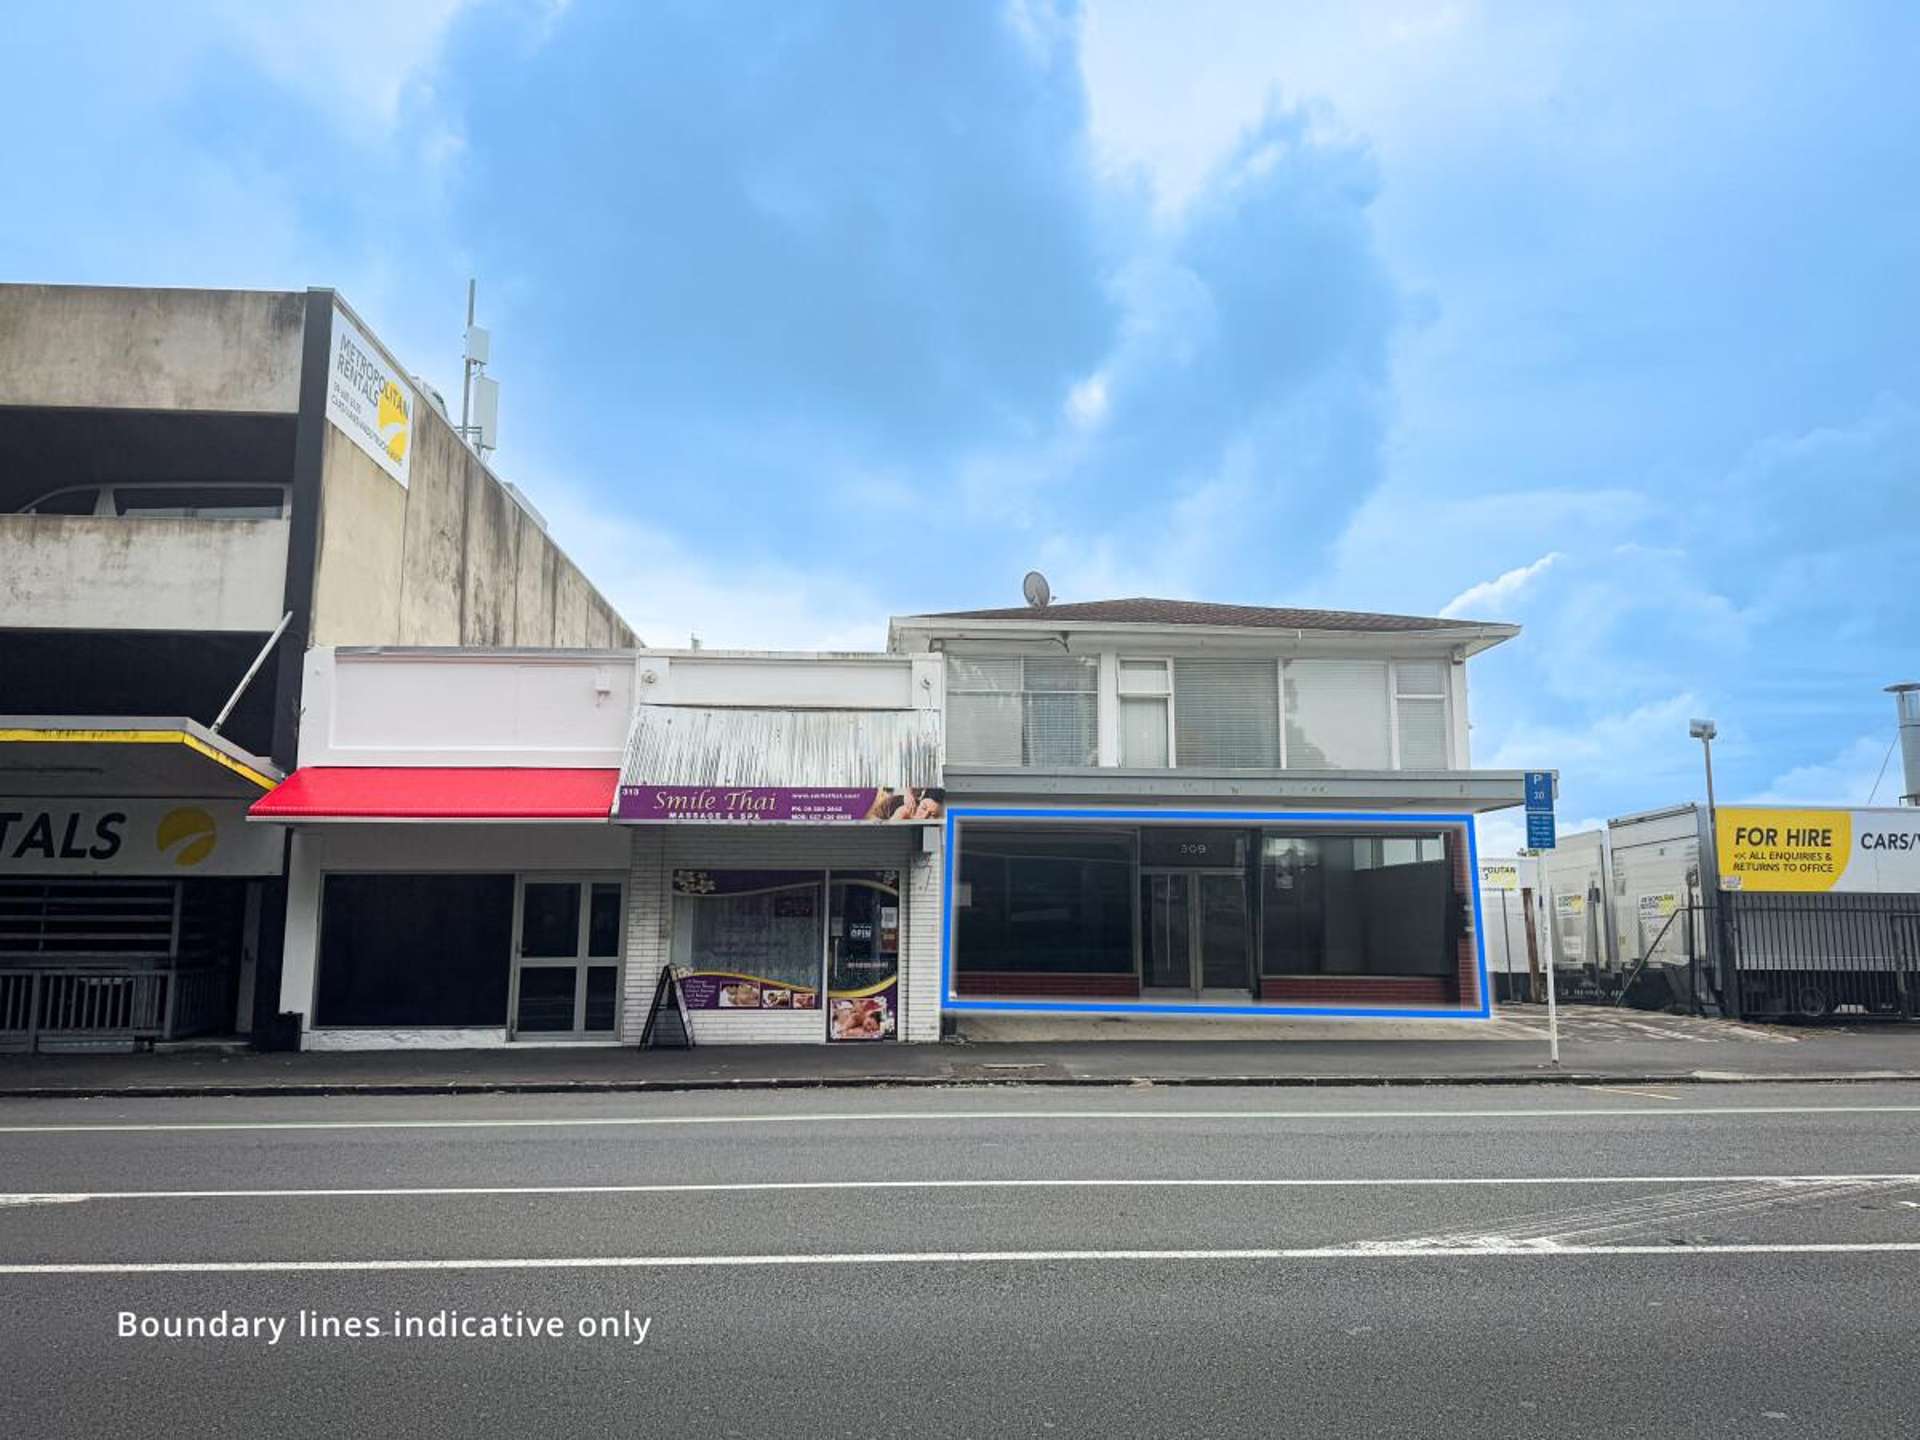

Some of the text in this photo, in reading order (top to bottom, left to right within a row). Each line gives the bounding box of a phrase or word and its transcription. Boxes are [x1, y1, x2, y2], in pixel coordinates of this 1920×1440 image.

[337, 352, 379, 408] RENTALS
[340, 332, 410, 420] METROPOLITAN
[1533, 774, 1544, 785] P
[652, 788, 777, 811] Smile Thai
[669, 812, 722, 820] MASSAGE
[740, 812, 761, 820] SPA
[0, 812, 127, 860] TALS
[1735, 827, 1833, 848] FOR HIRE
[1860, 832, 1920, 851] CARS/
[1750, 852, 1767, 861] ALL
[1769, 852, 1823, 862] ENQUIRIES
[1825, 853, 1833, 861] &
[1732, 863, 1834, 873] RETURNS TO OFFICE
